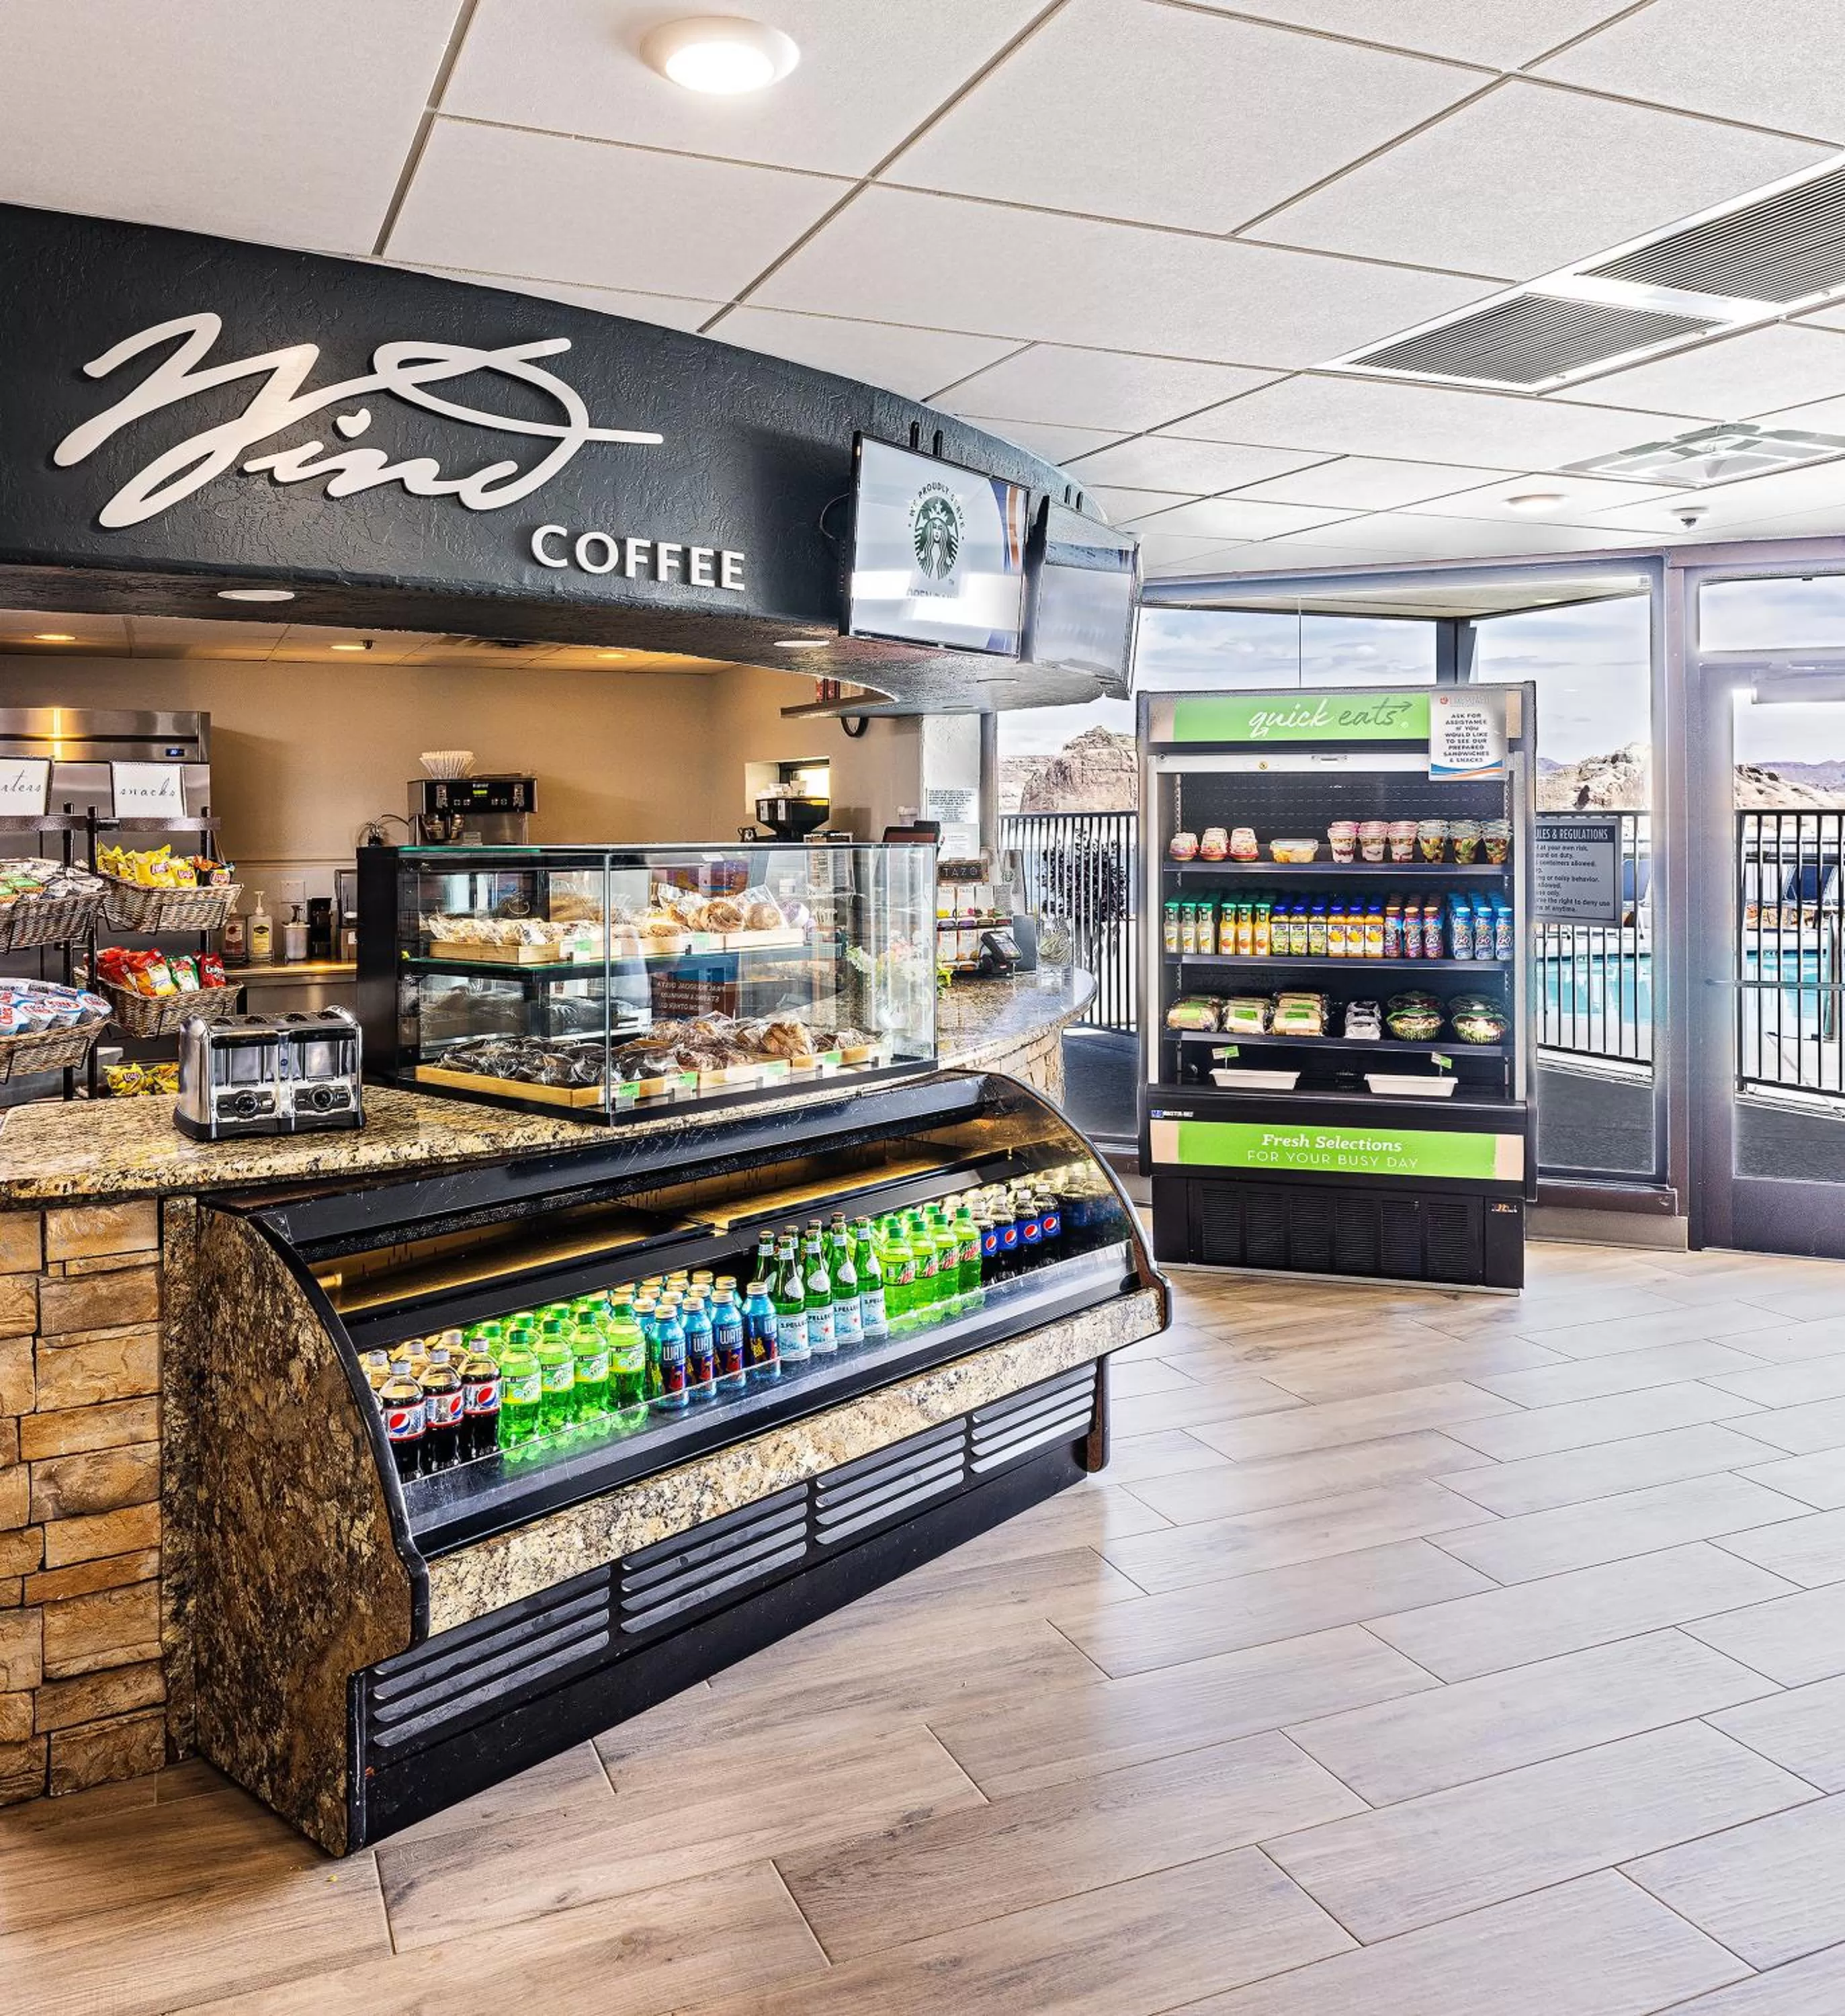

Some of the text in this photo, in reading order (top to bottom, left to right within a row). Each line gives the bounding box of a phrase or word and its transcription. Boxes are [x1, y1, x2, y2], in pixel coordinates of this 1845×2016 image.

[918, 482, 949, 499] PROUDLY
[951, 494, 966, 528] SERVE
[531, 523, 746, 591] COFFEE
[1248, 698, 1412, 739] quick eats
[1, 769, 41, 792] rters
[120, 778, 175, 797] snacks
[1535, 828, 1608, 839] ULES & REGULATIONS
[942, 867, 978, 877] TAZO
[1262, 1134, 1403, 1152] Fresh Selections
[1247, 1150, 1419, 1169] FOR YOUR BUSY DAY
[720, 1326, 743, 1345] WATE
